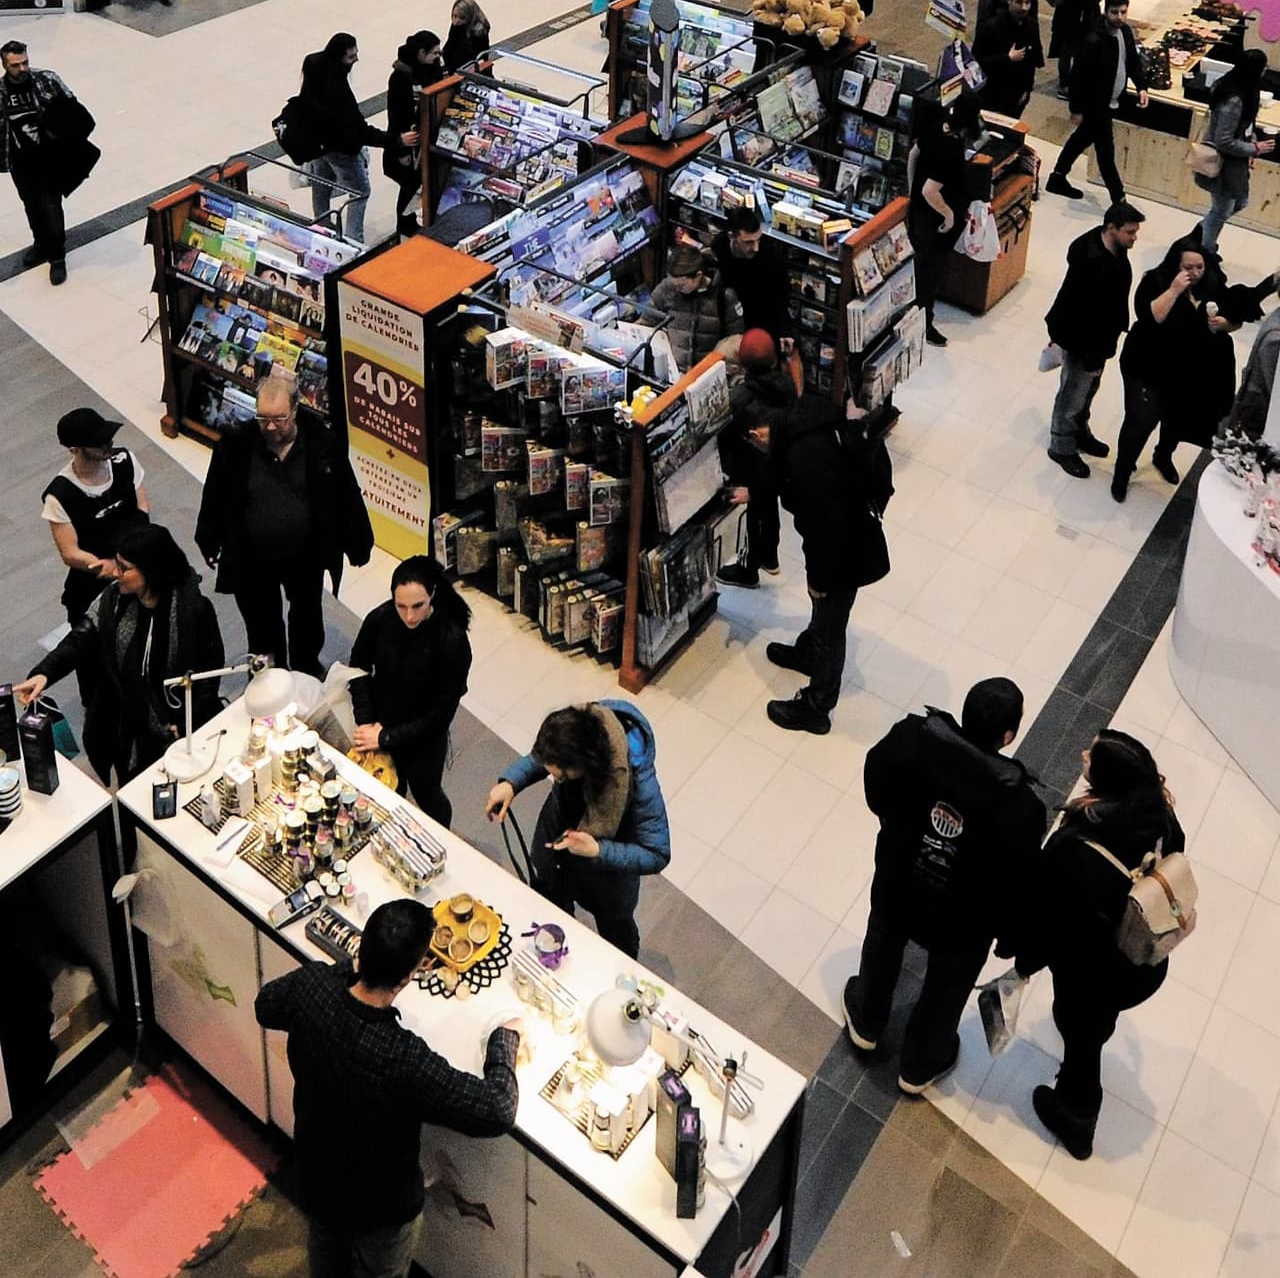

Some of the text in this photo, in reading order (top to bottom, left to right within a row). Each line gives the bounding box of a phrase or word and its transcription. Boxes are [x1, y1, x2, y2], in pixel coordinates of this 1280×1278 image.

[352, 305, 413, 337] LIQUIDATION
[361, 300, 400, 322] GRANDE
[345, 313, 419, 352] DE CALENDRIER
[353, 362, 417, 407] 40%
[354, 396, 421, 436] DE RABAIS SUR
[359, 416, 418, 453] CALENDRIERS
[368, 411, 408, 438] TOUS LES
[362, 489, 426, 527] ATUITEMENT
